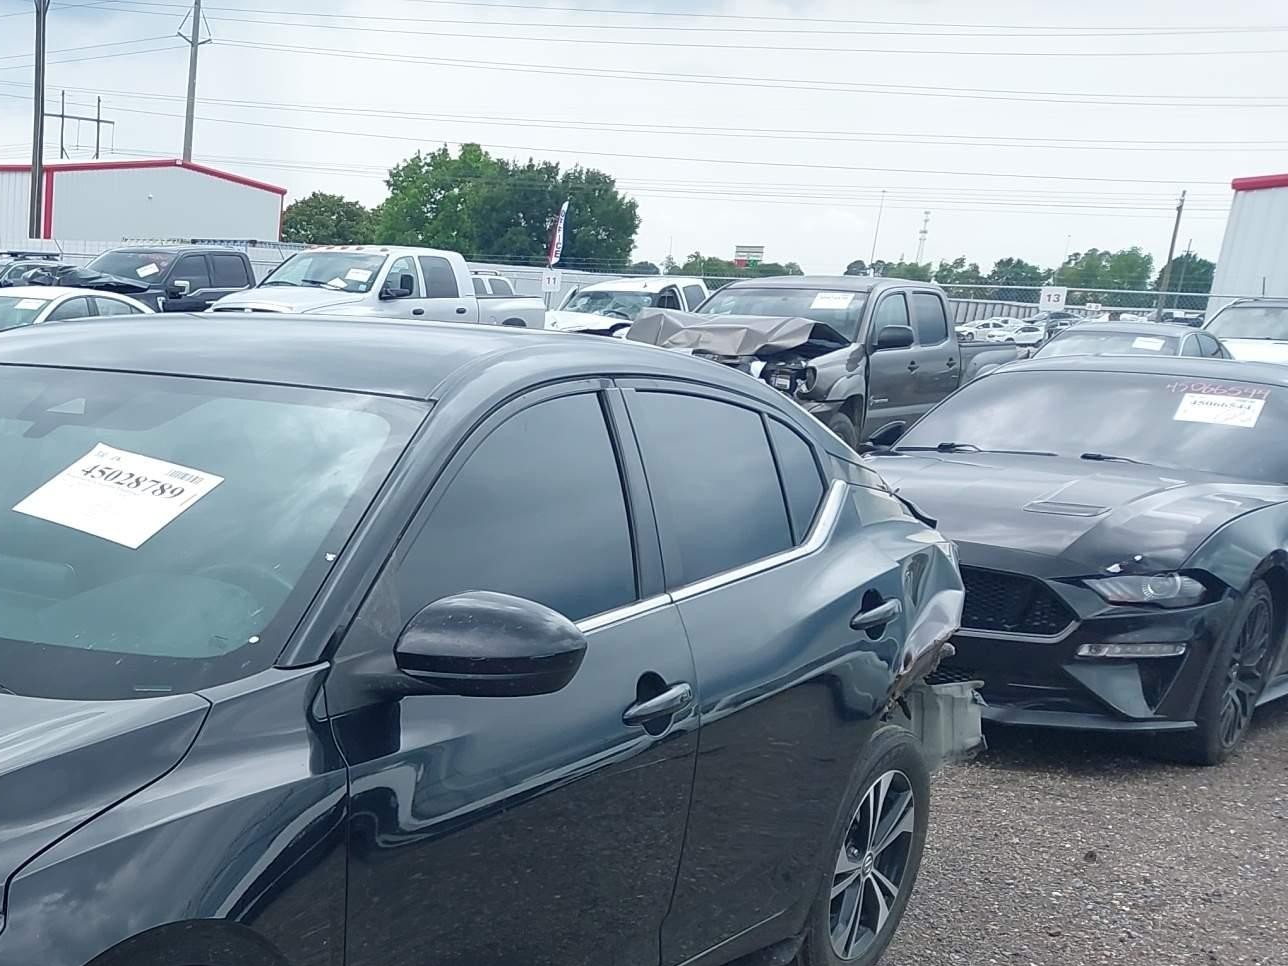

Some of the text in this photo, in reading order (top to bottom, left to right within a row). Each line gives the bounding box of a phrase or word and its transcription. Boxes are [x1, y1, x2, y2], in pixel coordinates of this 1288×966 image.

[554, 210, 567, 258] OFFICE
[545, 277, 556, 285] 11
[1046, 293, 1061, 303] 13
[81, 464, 185, 499] 45028789
